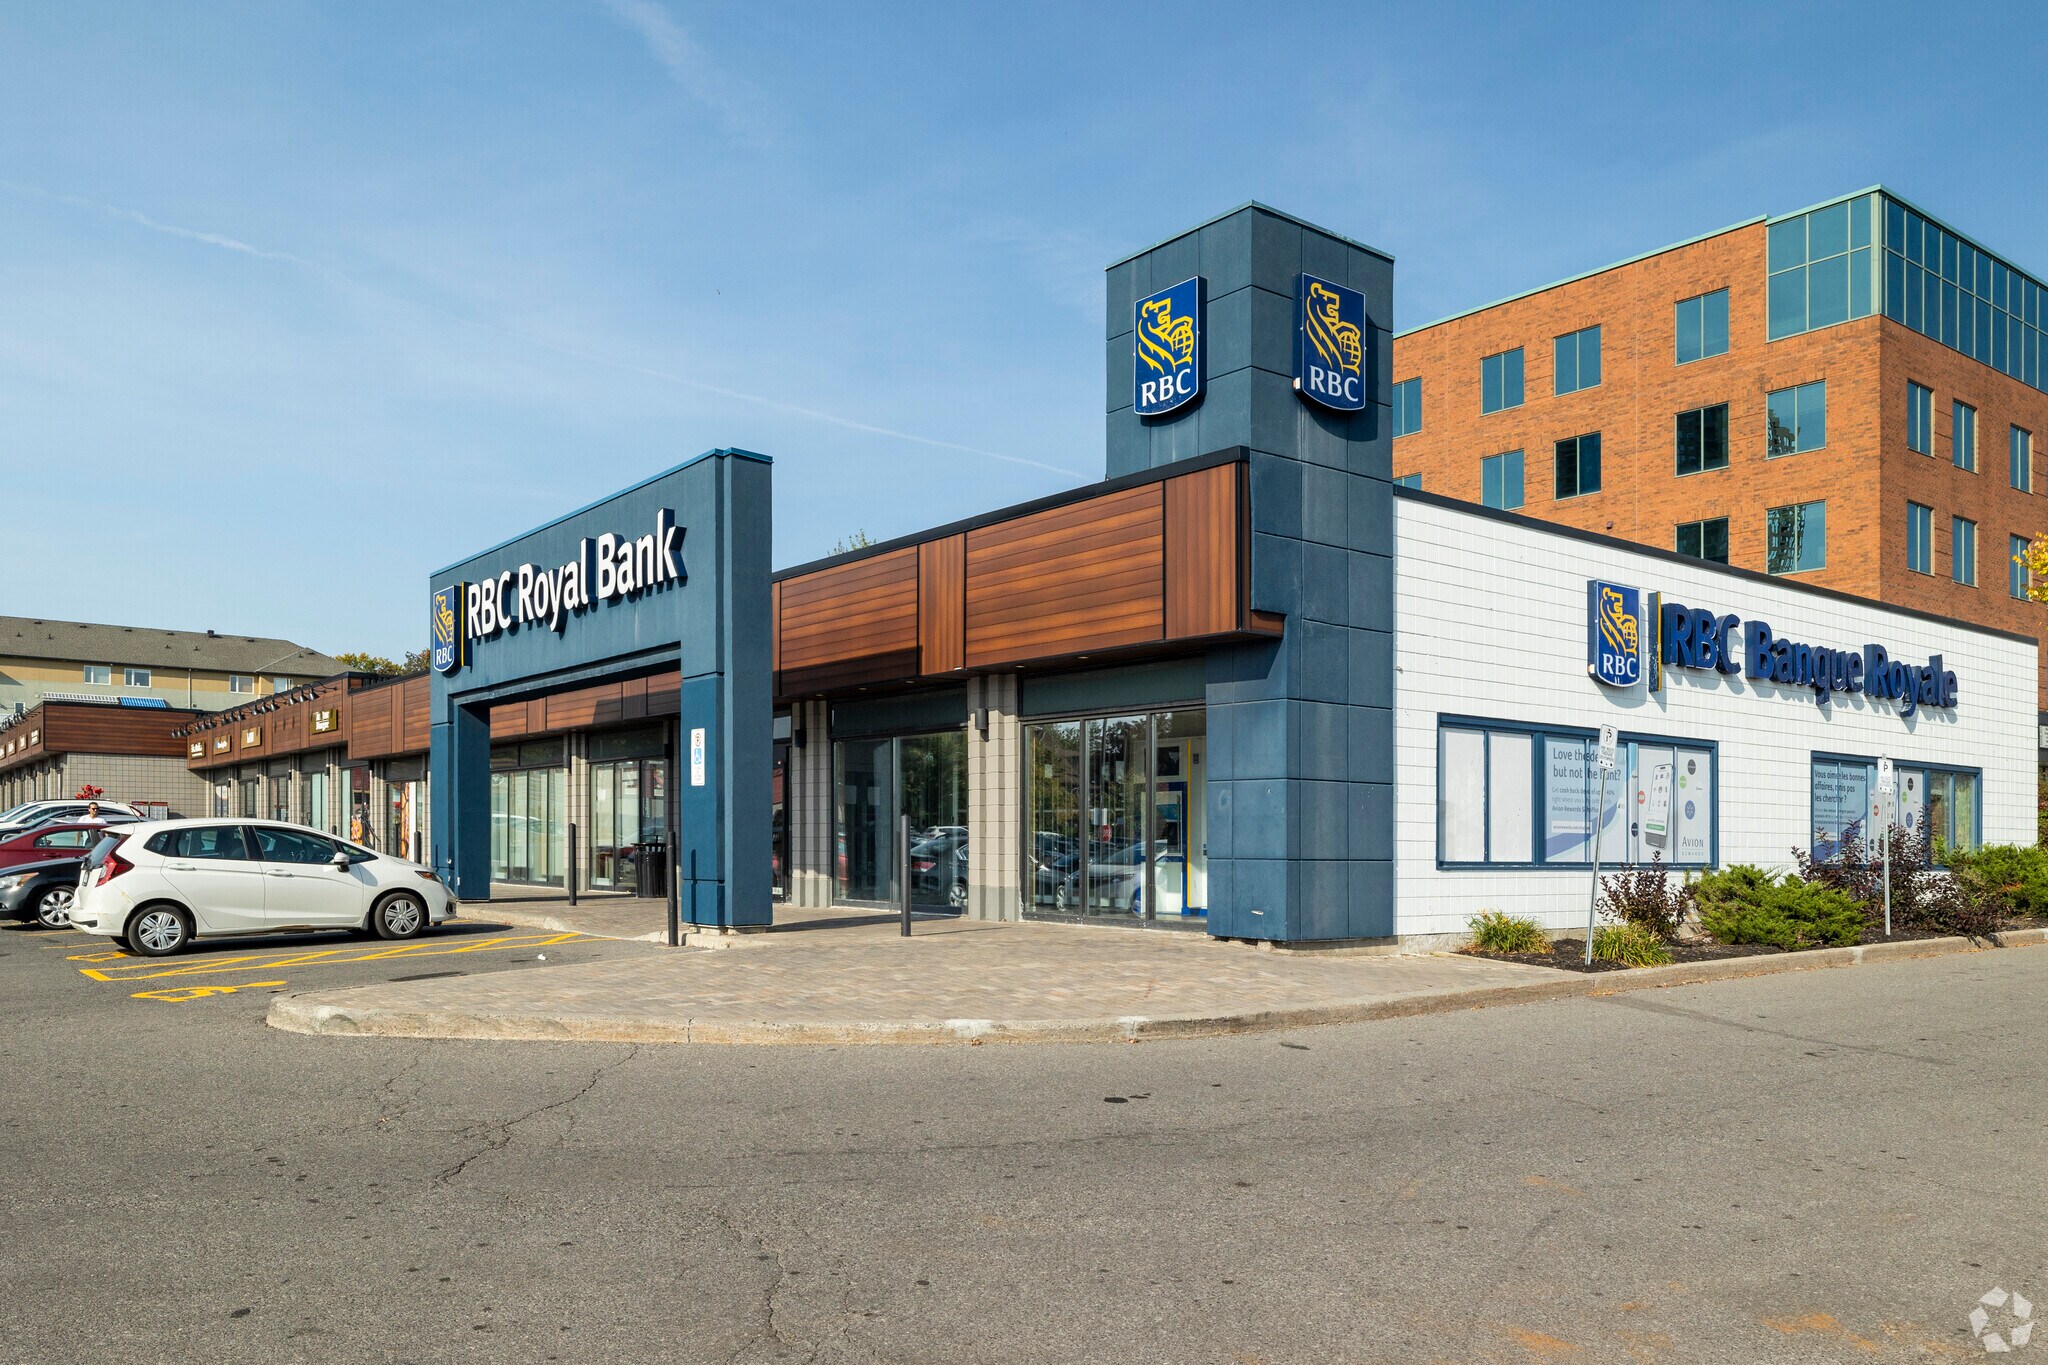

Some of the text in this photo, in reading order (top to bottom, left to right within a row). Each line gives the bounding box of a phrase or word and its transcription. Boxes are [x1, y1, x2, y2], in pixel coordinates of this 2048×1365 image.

[1141, 368, 1191, 407] RBC
[1310, 365, 1359, 402] RBC
[468, 508, 688, 639] RBC Royal Bank
[436, 646, 453, 666] RBC
[1602, 653, 1637, 678] RBC
[1662, 603, 1959, 717] RBC Banque Royale
[1553, 748, 1573, 760] Love
[1553, 764, 1567, 778] but
[1569, 766, 1583, 779] not
[1814, 770, 1827, 779] Vous
[1847, 785, 1855, 794] pas
